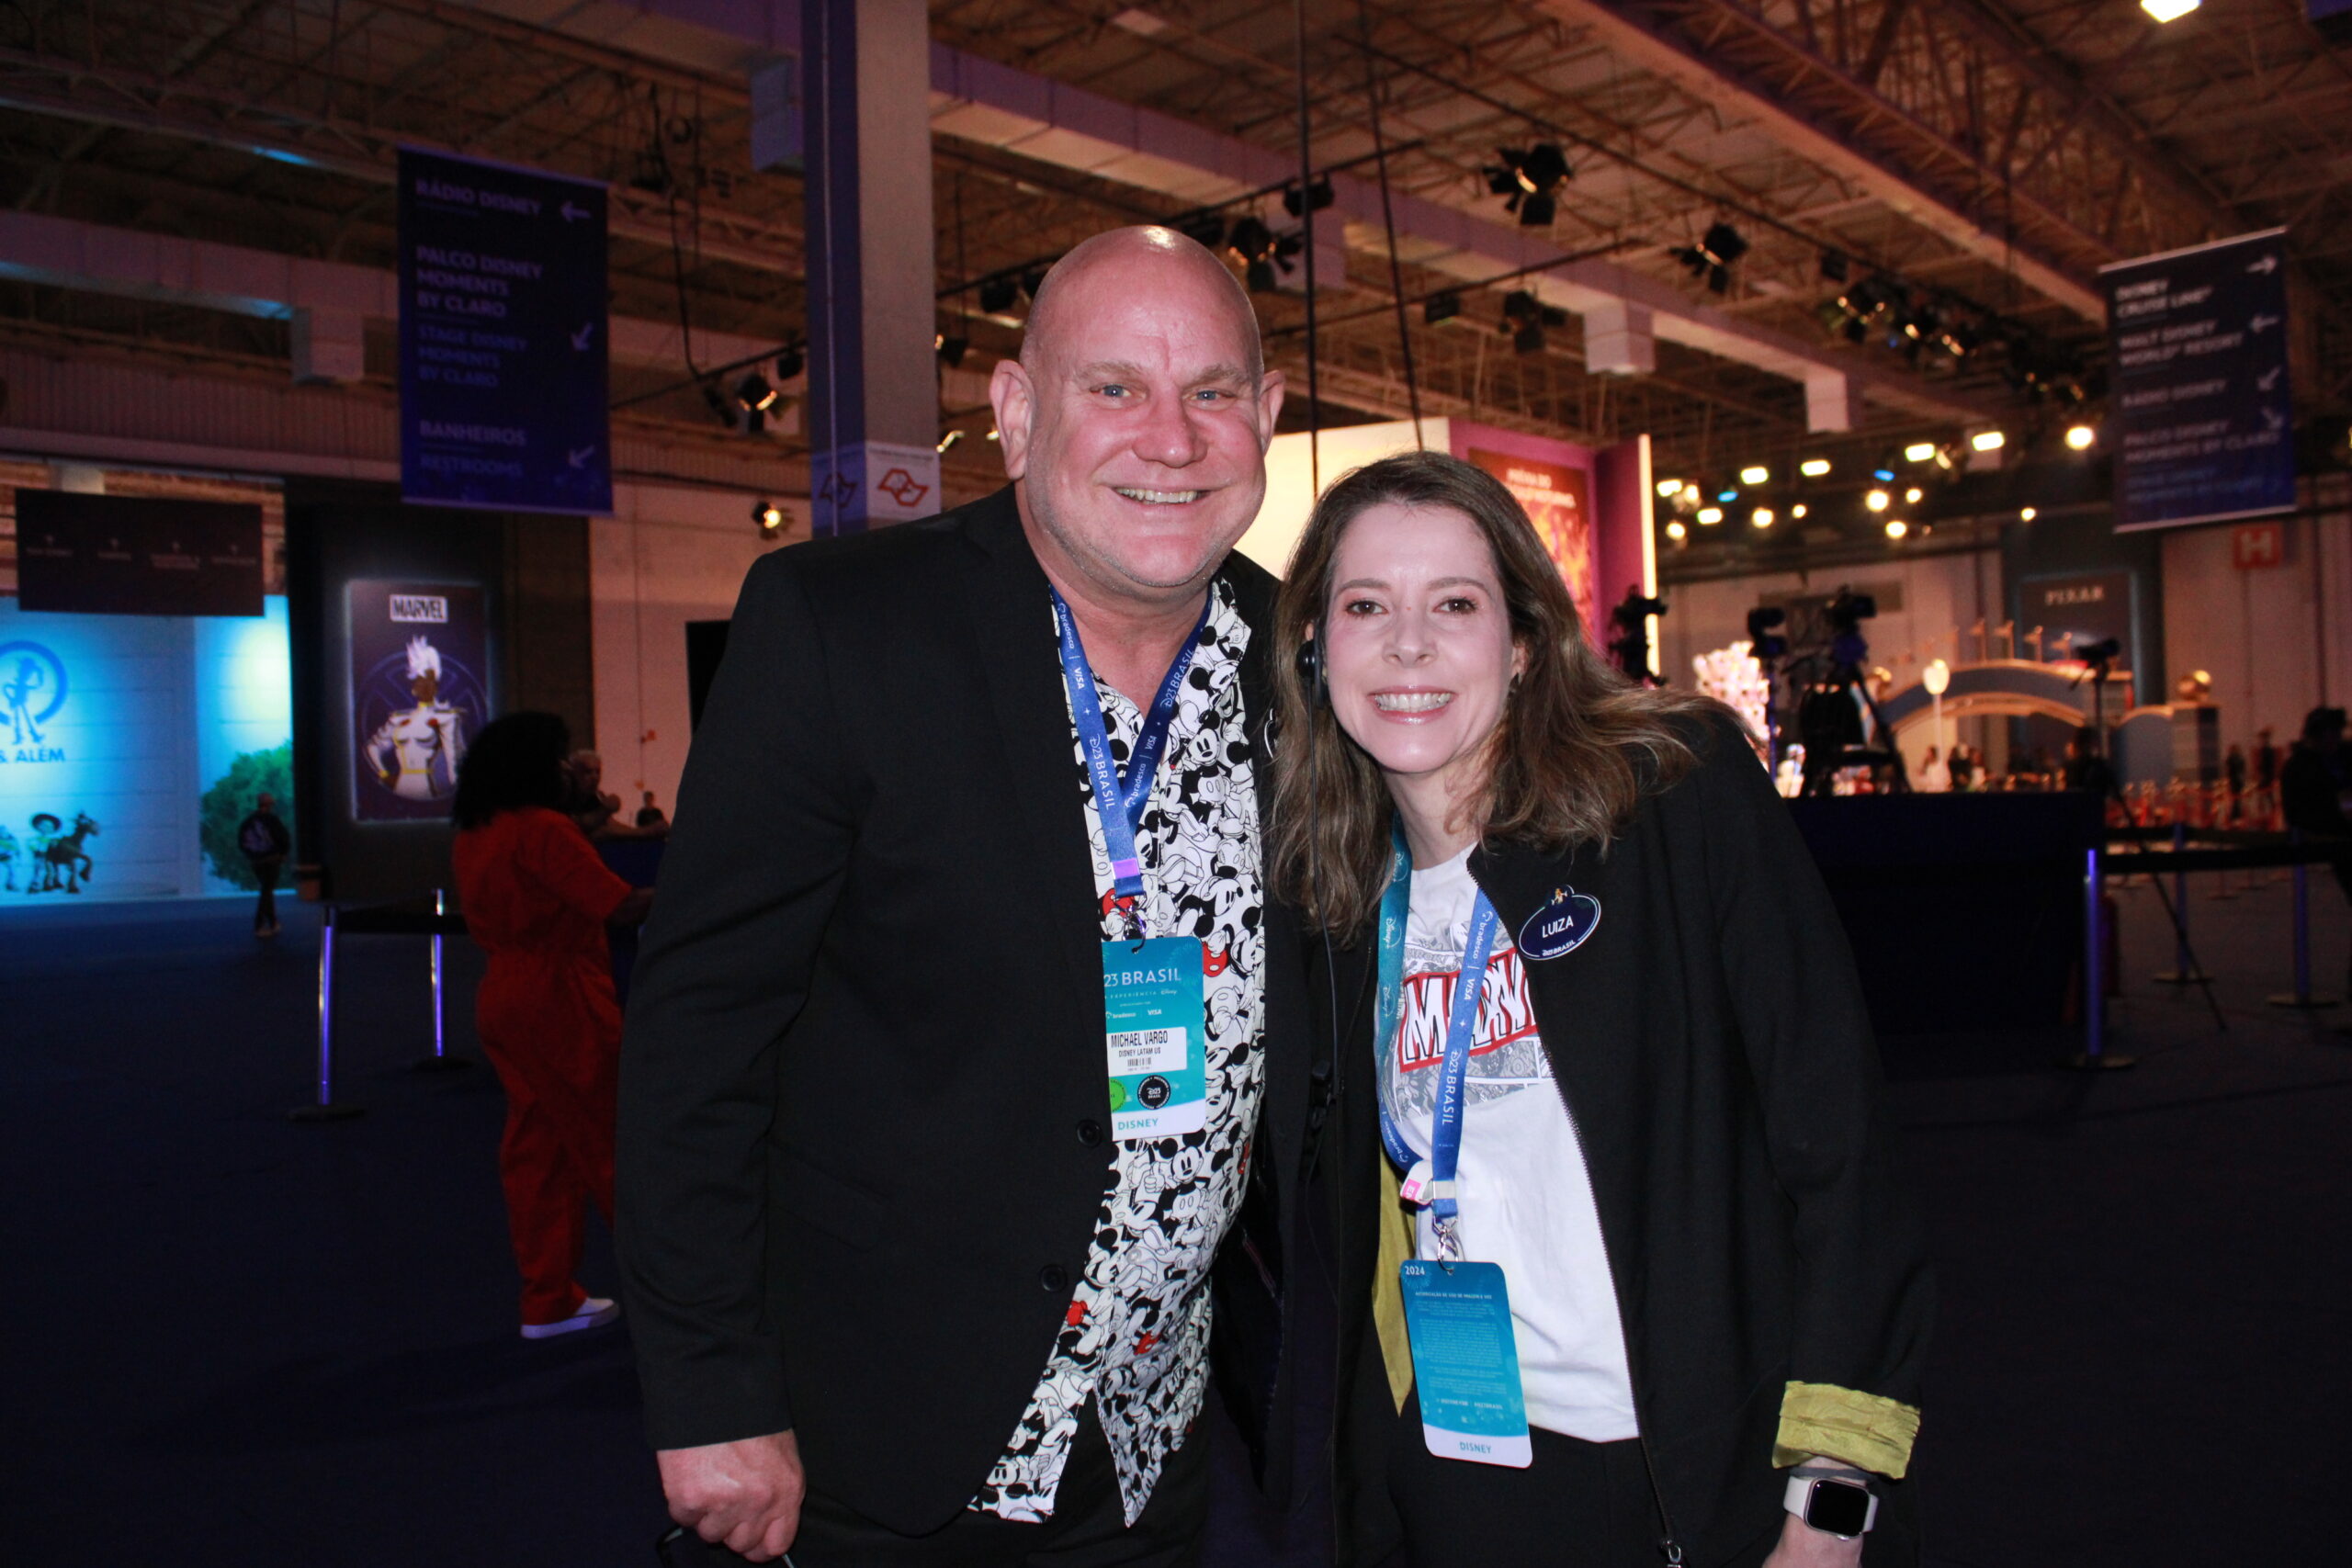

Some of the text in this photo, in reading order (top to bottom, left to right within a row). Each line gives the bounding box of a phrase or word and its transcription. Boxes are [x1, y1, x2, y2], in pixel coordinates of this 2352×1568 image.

[479, 190, 543, 216] DISNEY
[416, 244, 544, 279] PALCO DISNEY
[416, 267, 510, 297] MOMENTS
[416, 289, 507, 318] BY CLARO
[419, 419, 528, 447] BANHEIROS
[2045, 585, 2105, 605] PIXAR
[393, 598, 444, 619] MARVEL
[1059, 614, 1085, 689] bradesco VISA
[1170, 649, 1194, 689] BRASIL
[1131, 735, 1158, 797] bradesco VISA
[1095, 761, 1115, 810] BRASIL
[1542, 915, 1574, 938] LUIZA
[1553, 939, 1577, 954] BRASIL
[1464, 921, 1487, 1000] bradesco VISA
[1121, 967, 1182, 986] BRASIL
[1111, 1030, 1168, 1048] MICHAEL VARGO
[1118, 1049, 1136, 1057] DISNEY
[1137, 1048, 1153, 1056] LATAM
[1442, 1077, 1458, 1126] BRASIL
[1117, 1118, 1159, 1131] DISNEY
[1405, 1265, 1426, 1276] 2024
[1459, 1441, 1492, 1454] DISNEY
